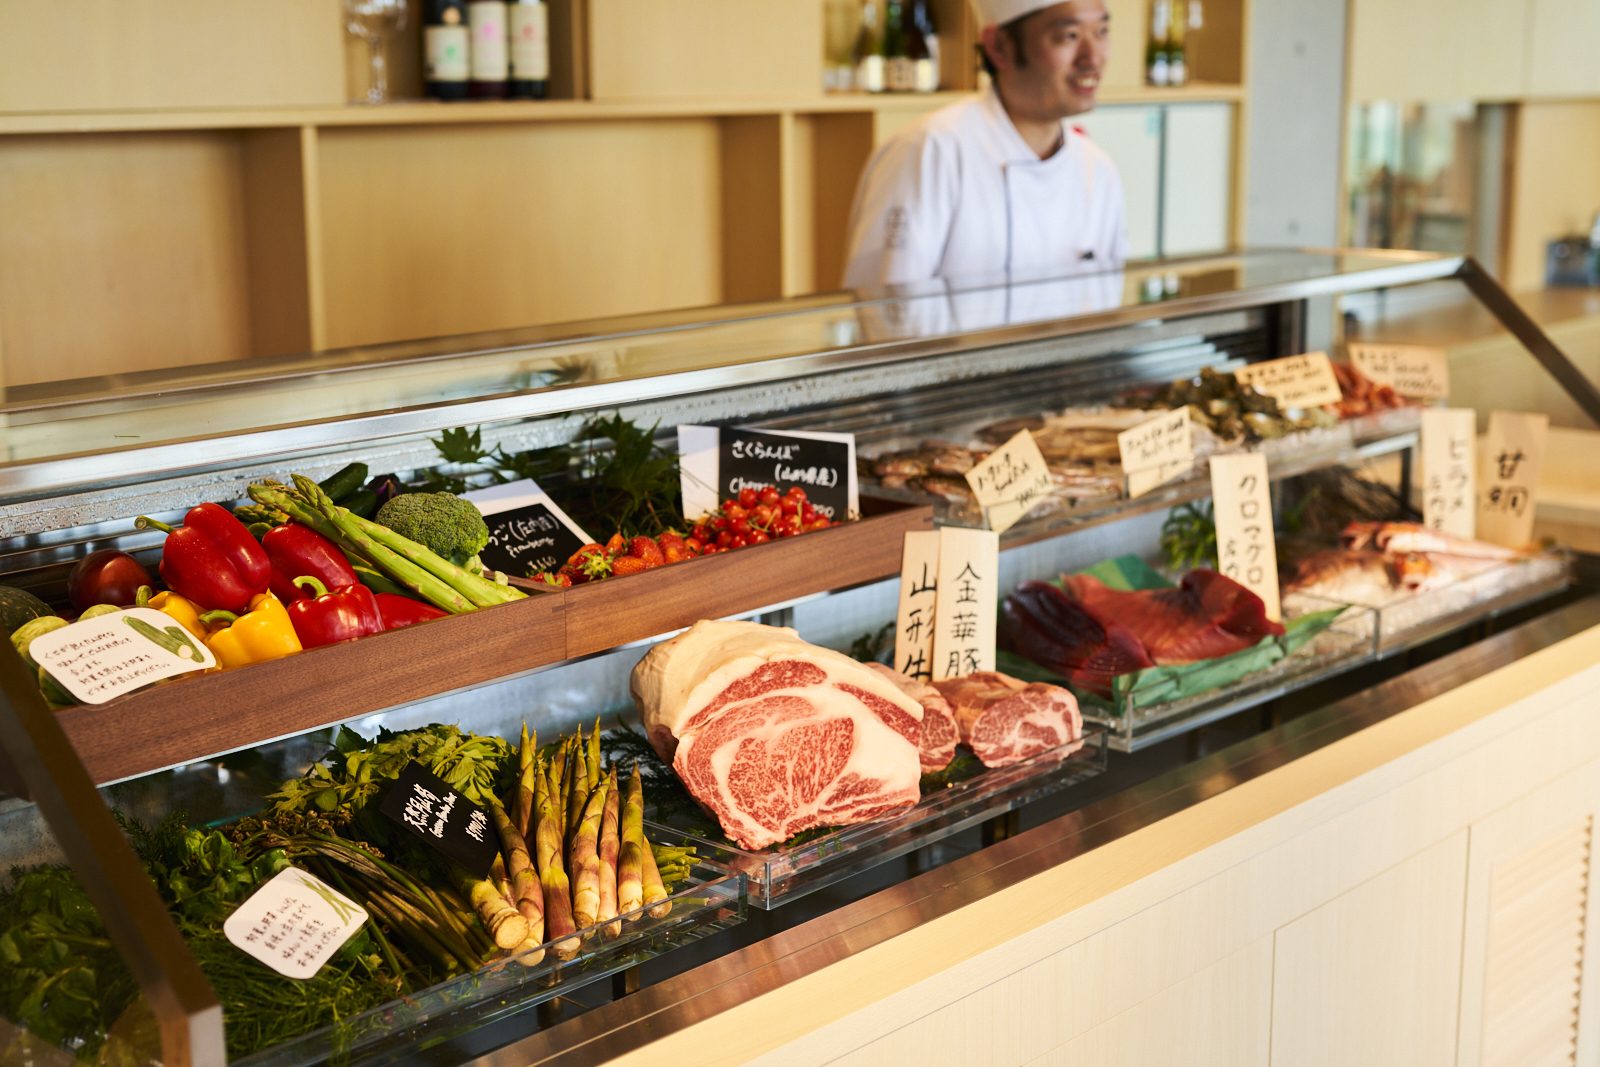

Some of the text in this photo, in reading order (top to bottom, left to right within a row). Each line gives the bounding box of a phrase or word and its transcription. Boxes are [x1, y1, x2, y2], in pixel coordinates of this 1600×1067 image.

[732, 439, 800, 461] さくらんぼ
[1239, 475, 1264, 585] クロマグロ
[902, 561, 938, 681] 山形牛
[944, 561, 982, 678] 金華豚
